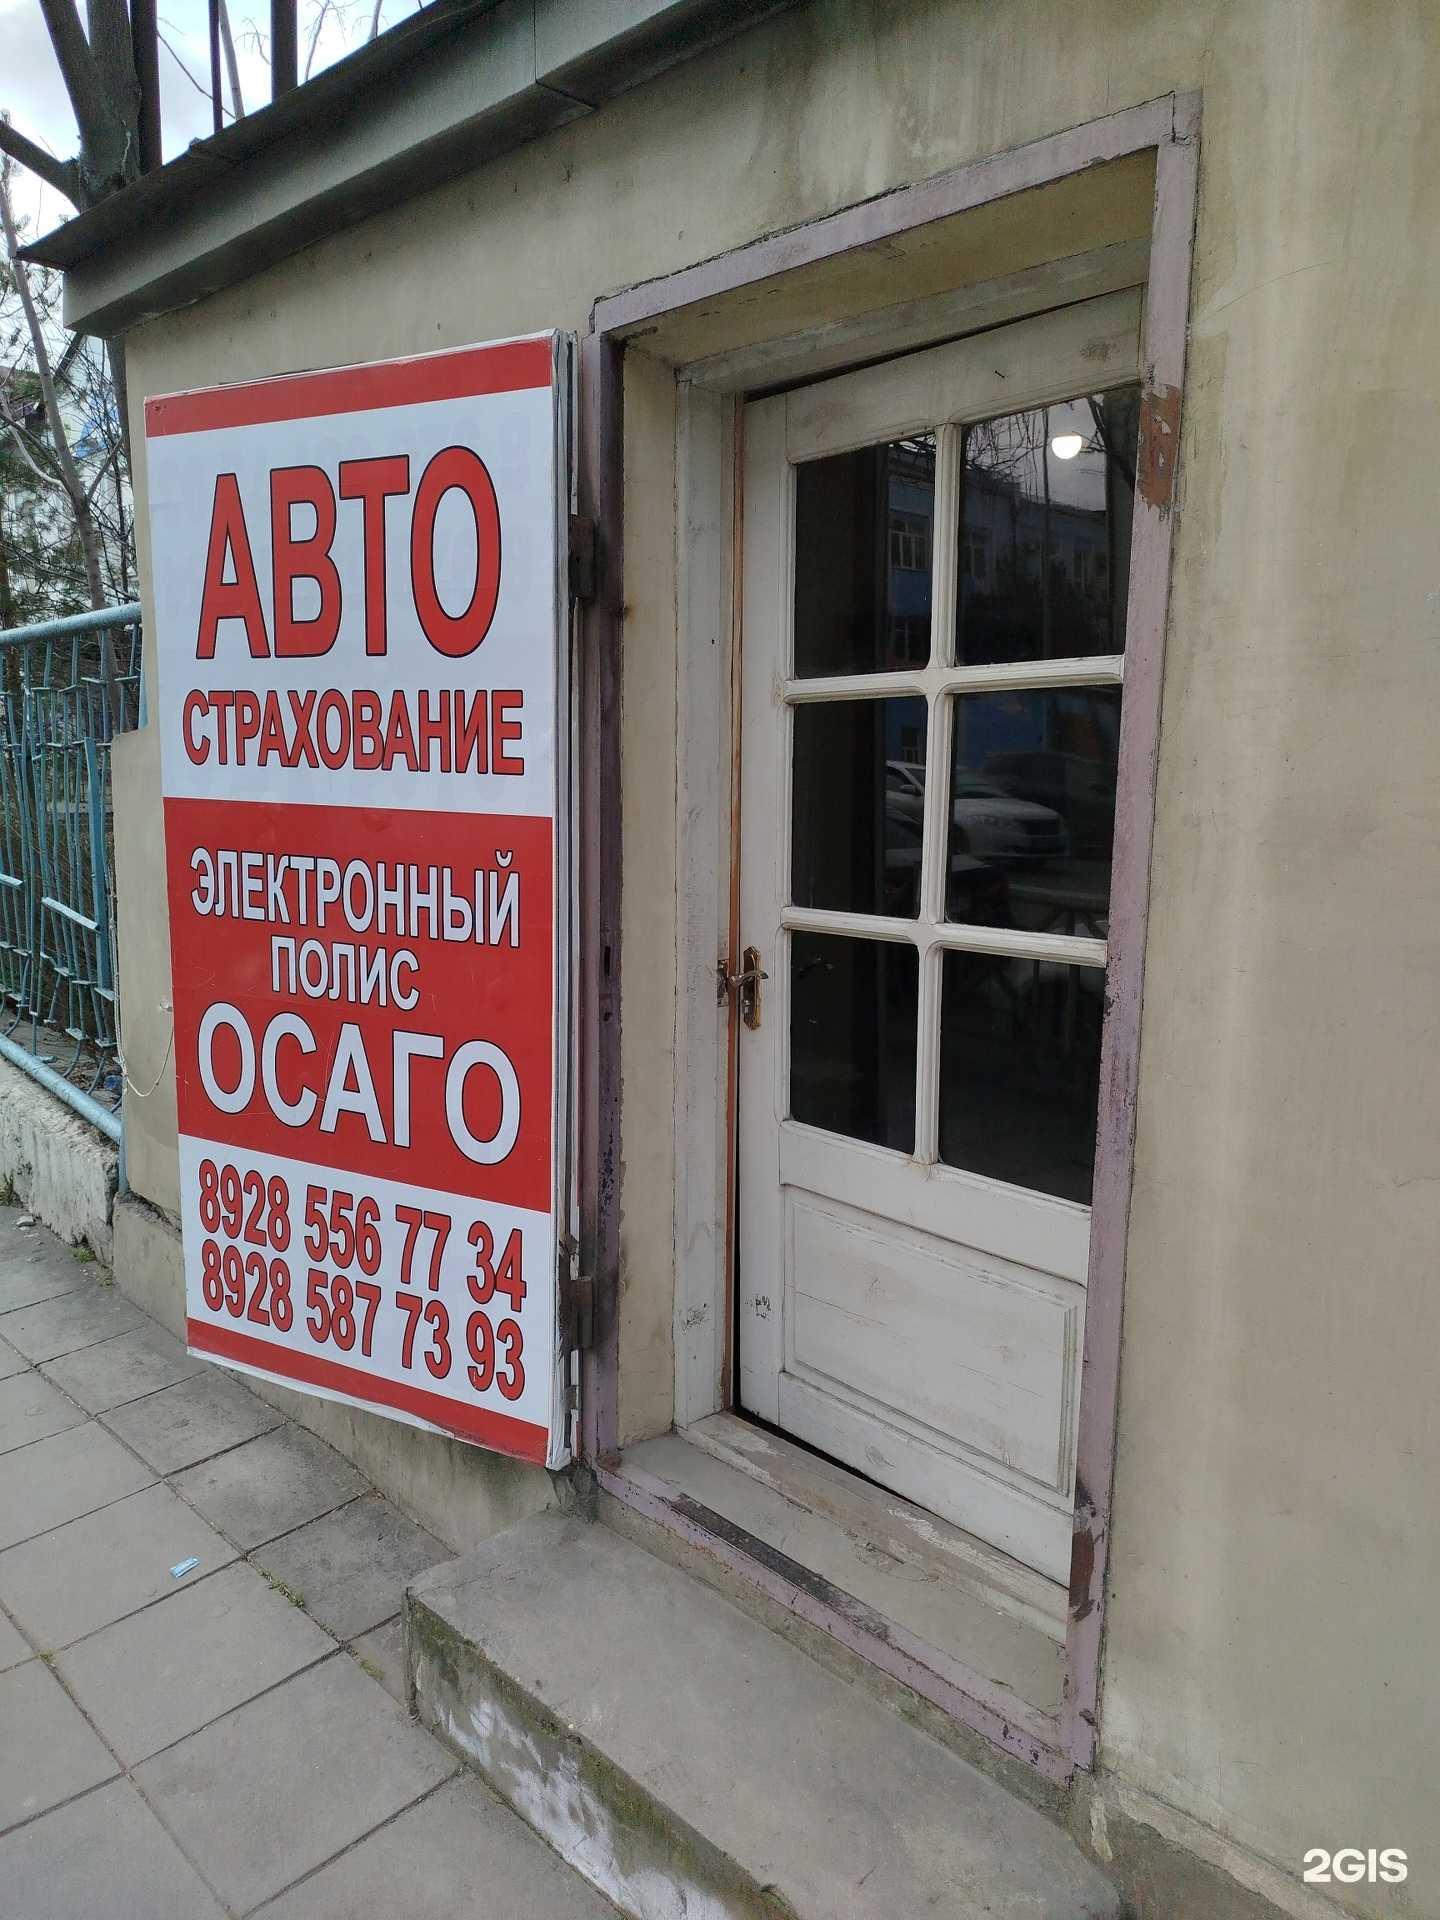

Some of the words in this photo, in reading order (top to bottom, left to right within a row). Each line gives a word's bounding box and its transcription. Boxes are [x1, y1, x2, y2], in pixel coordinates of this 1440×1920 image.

[196, 445, 501, 659] АВТО
[183, 688, 524, 776] СТРАХОВАНИЕ
[190, 846, 520, 948] ЭЛЕКТРОННЫЙ
[271, 935, 420, 1011] ПОЛИС
[198, 1001, 521, 1165] ОСАГО
[199, 1159, 291, 1252] 8928
[304, 1184, 381, 1276] 556
[395, 1204, 452, 1291] 77
[467, 1220, 526, 1312] 34
[202, 1239, 293, 1332] 8928
[306, 1268, 381, 1357] 587
[395, 1291, 452, 1379] 73
[466, 1310, 525, 1401] 93
